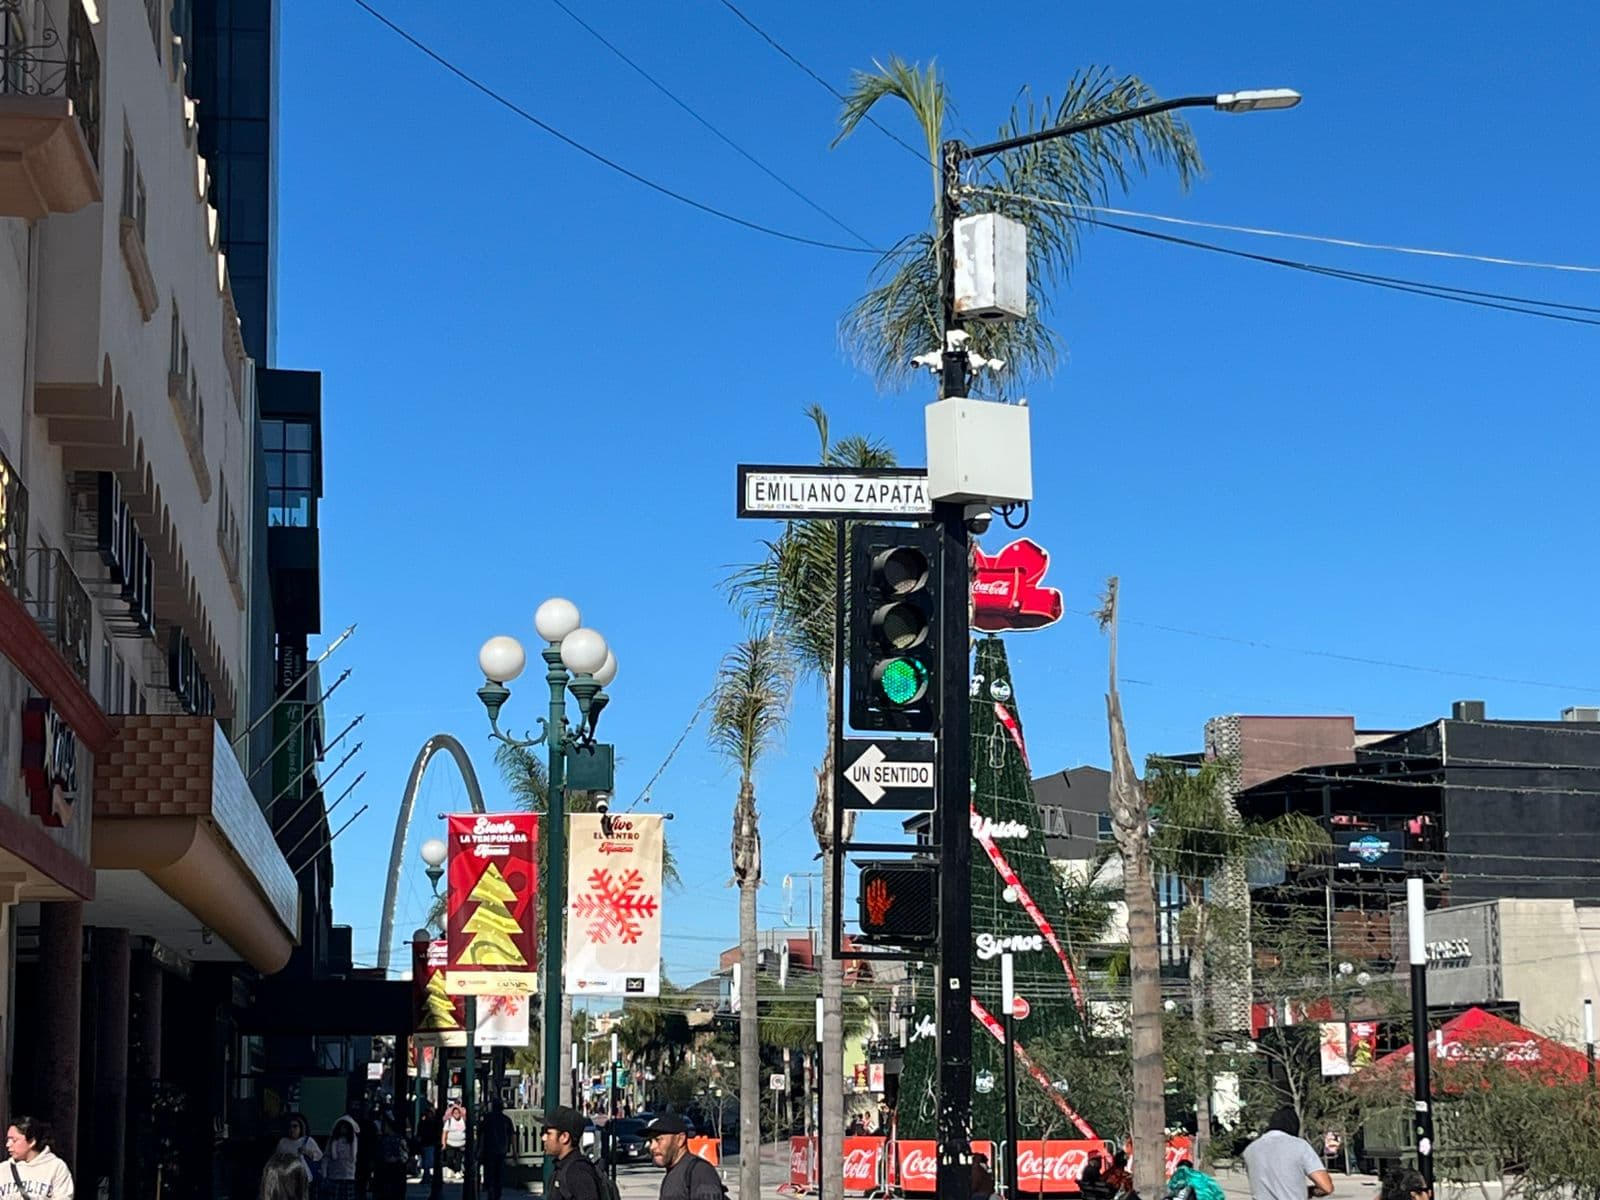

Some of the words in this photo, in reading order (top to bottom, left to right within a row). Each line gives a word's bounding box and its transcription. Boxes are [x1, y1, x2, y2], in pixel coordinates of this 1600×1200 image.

[755, 482, 846, 502] EMILIANO
[854, 484, 925, 503] ZAPATA
[111, 472, 156, 636] HOTEL
[283, 645, 293, 688] INDIGO
[853, 766, 870, 782] UN
[874, 767, 929, 783] SENTIDO
[473, 817, 515, 834] Siente
[608, 815, 633, 831] Vive
[460, 835, 471, 843] LA
[472, 833, 527, 843] TEMPORADA
[606, 832, 640, 840] ENTRO
[1017, 1149, 1089, 1181] Coca-Col
